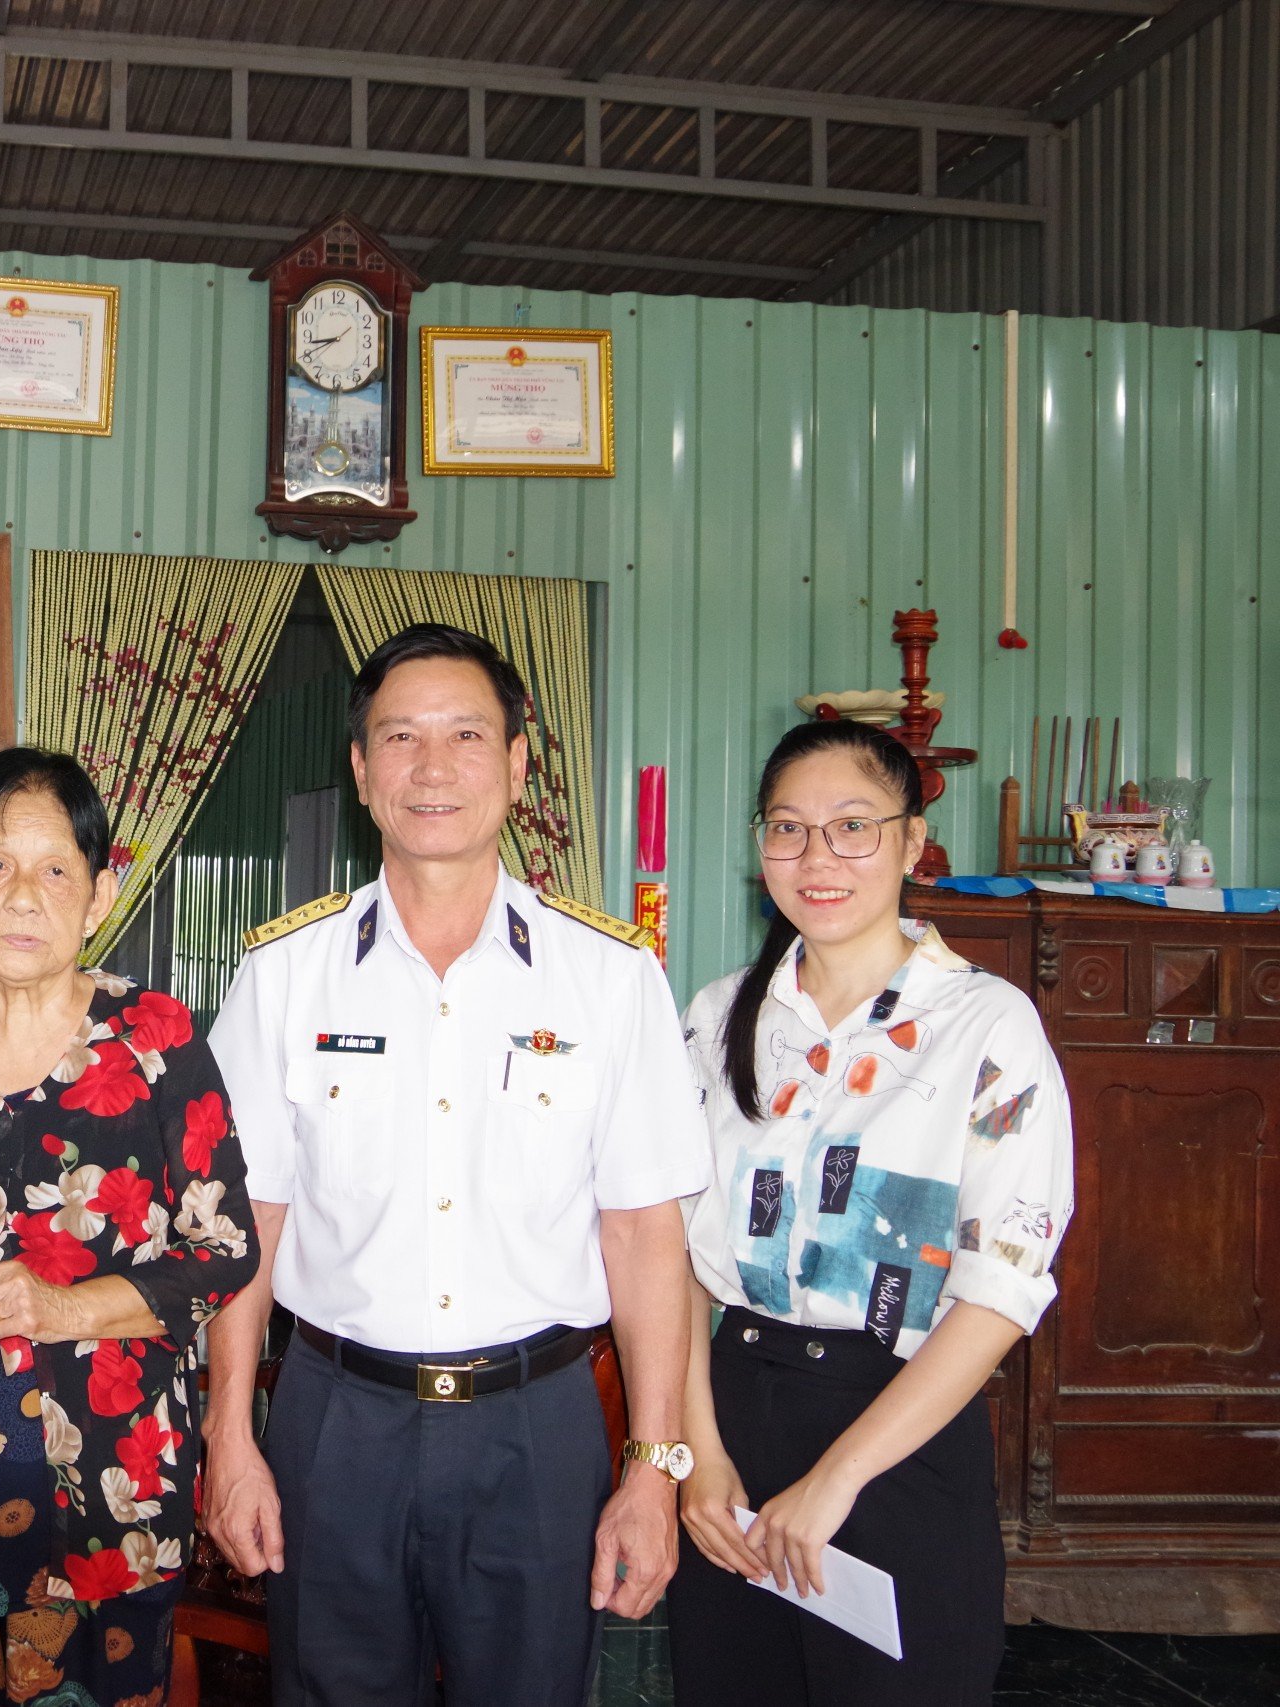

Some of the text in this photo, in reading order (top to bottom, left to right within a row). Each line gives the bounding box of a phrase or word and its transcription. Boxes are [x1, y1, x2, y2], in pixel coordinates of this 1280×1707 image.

[313, 296, 323, 310] 11
[331, 290, 345, 305] 12
[355, 299, 360, 313] 1
[301, 311, 314, 325] 10
[363, 314, 372, 330] 2
[303, 329, 312, 343] 9
[363, 335, 372, 349] 3
[303, 349, 312, 364] 8
[363, 355, 371, 368] 4
[313, 366, 322, 379] 7
